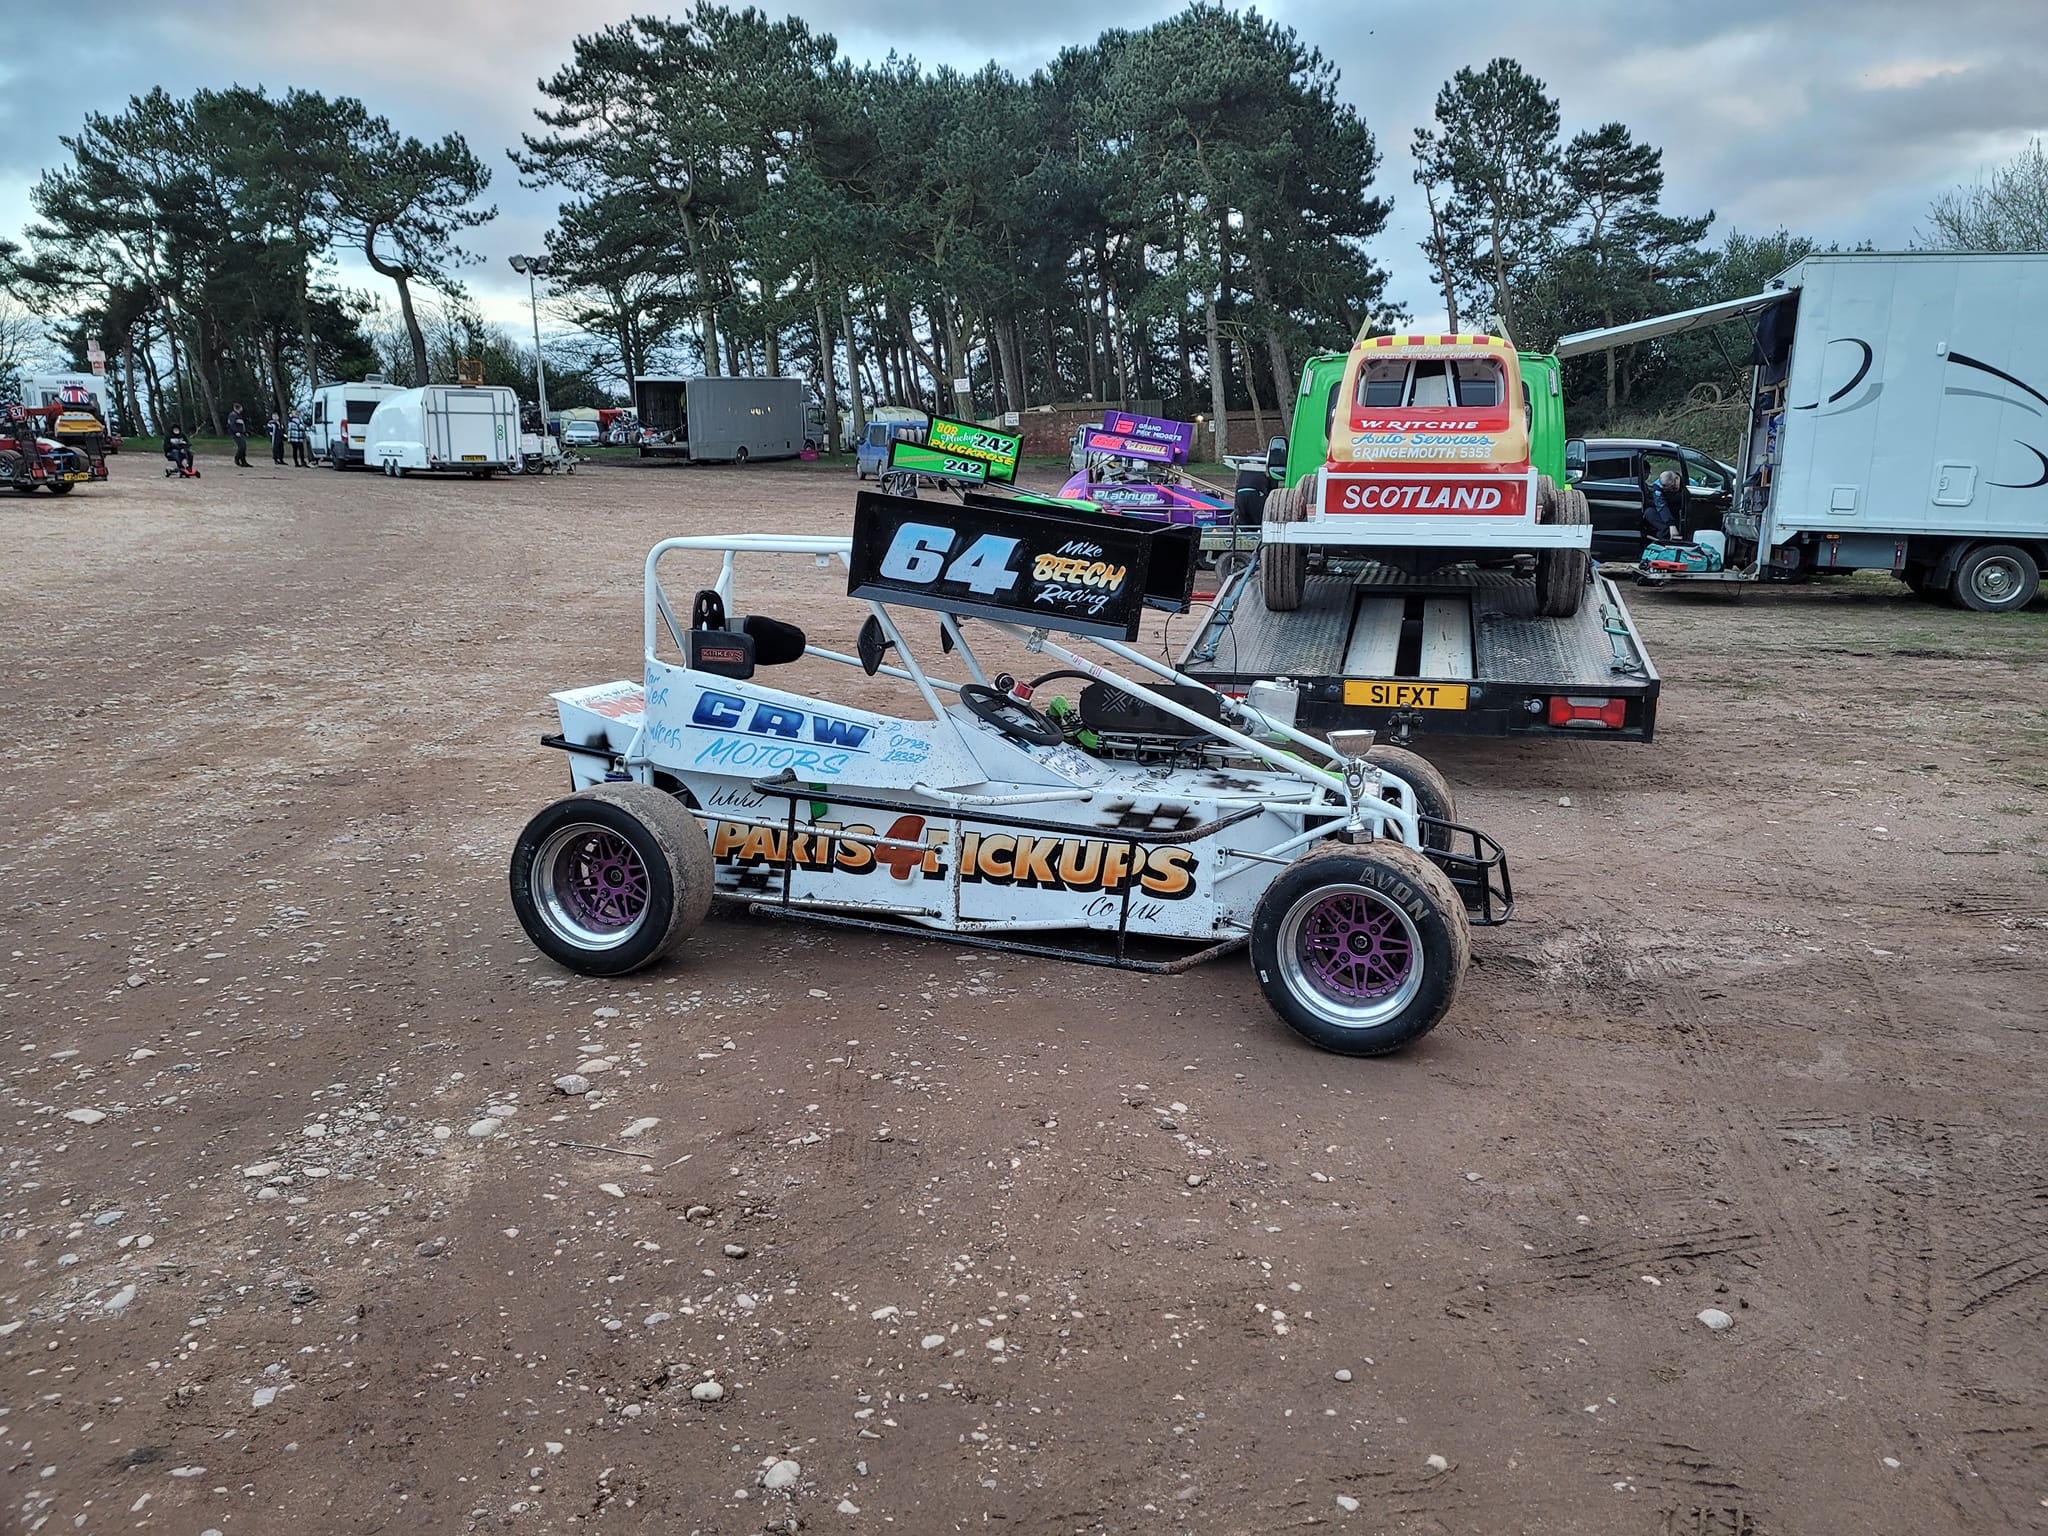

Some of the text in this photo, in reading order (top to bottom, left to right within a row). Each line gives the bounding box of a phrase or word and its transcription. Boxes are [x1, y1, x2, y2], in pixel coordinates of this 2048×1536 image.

[11, 407, 24, 417] 37
[1138, 423, 1162, 432] GRAND
[1153, 432, 1182, 441] MIDGETS
[1361, 420, 1479, 431] W. RITCHIE
[972, 432, 1014, 456] 242
[1352, 433, 1497, 447] Auto Services
[930, 439, 1015, 466] PLUCKROSE
[1352, 447, 1492, 461] GRANGEMOUTH 5353
[944, 458, 982, 475] 242
[1343, 485, 1502, 511] SCOTLAND
[879, 521, 1022, 595] 64
[1032, 553, 1126, 592] BEECH
[1034, 584, 1109, 615] Racing
[1396, 687, 1440, 706] FXT
[692, 691, 870, 747] CRW
[694, 737, 850, 775] MOTORS
[1358, 865, 1431, 922] AVON
